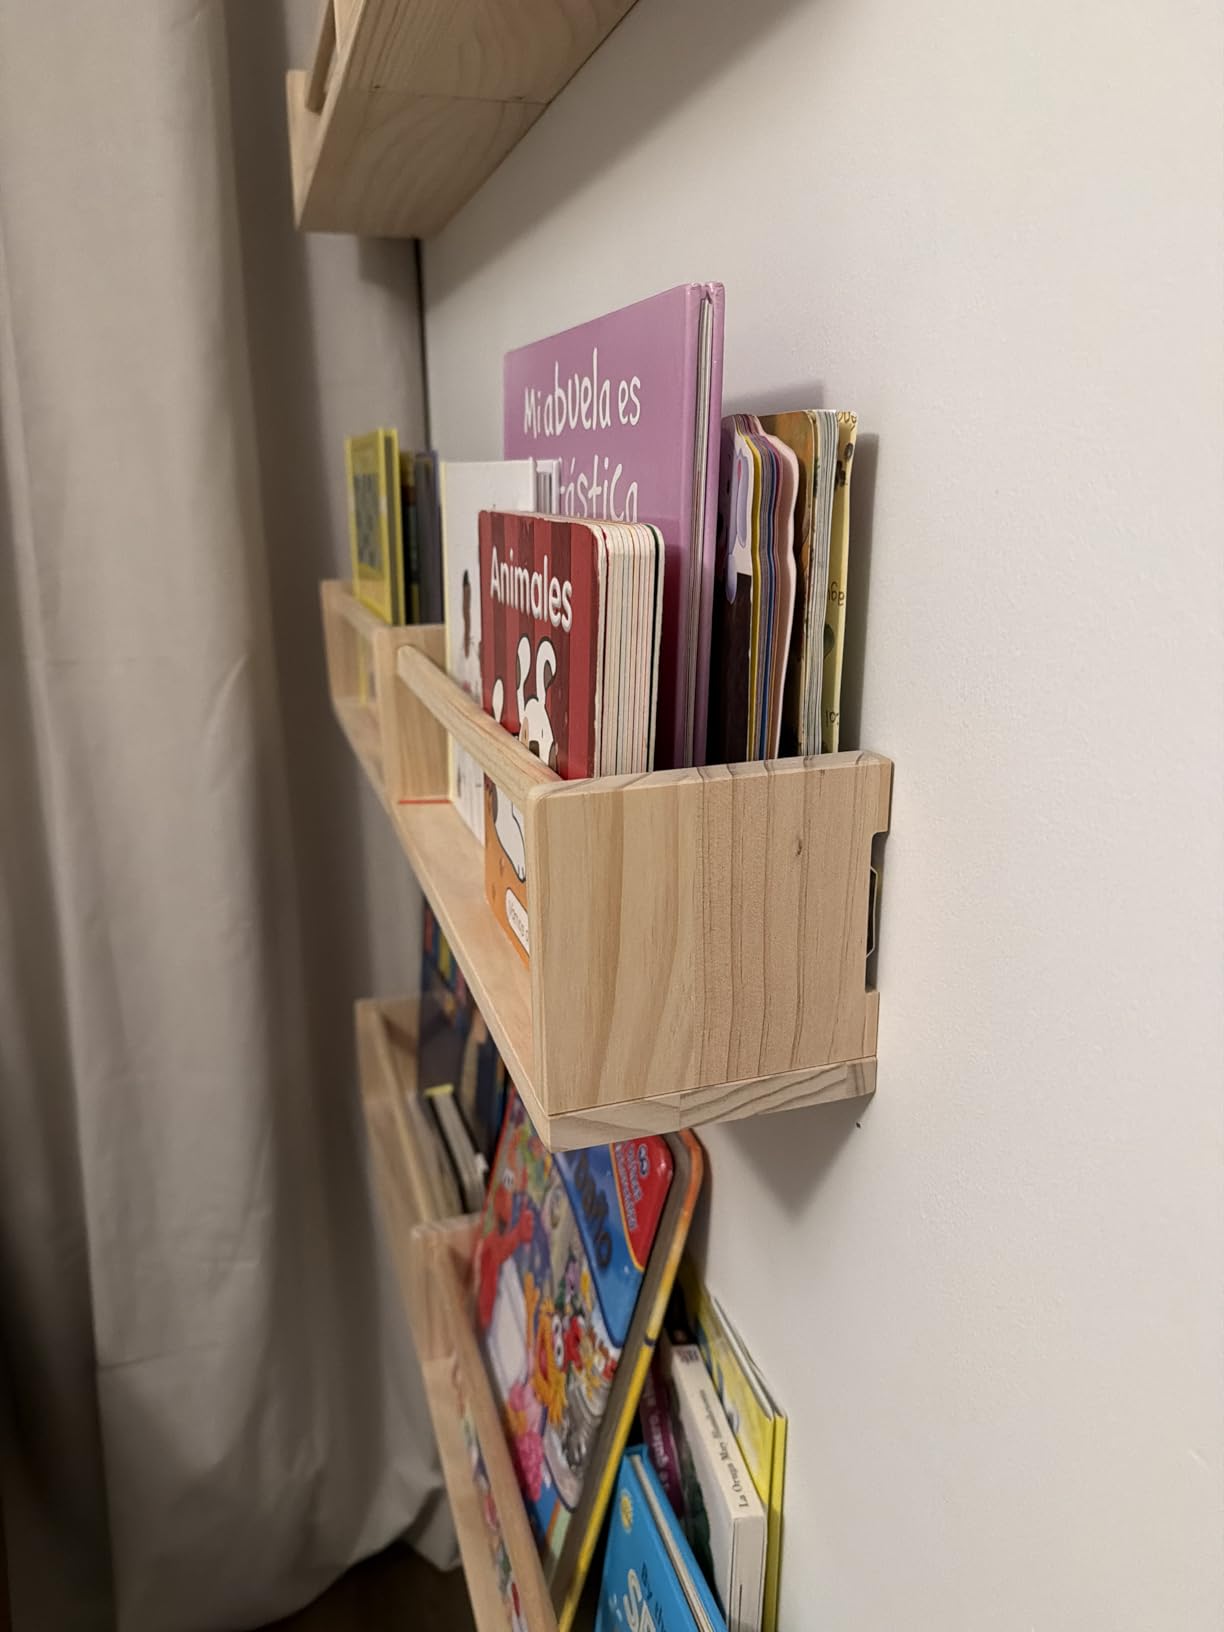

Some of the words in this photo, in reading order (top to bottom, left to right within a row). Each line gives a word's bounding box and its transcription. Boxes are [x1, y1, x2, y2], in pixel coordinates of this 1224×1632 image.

[524, 387, 541, 440] Mi
[543, 347, 612, 437] abuela
[617, 375, 641, 426] es
[490, 546, 573, 633] Animales
[738, 1494, 750, 1508] La
